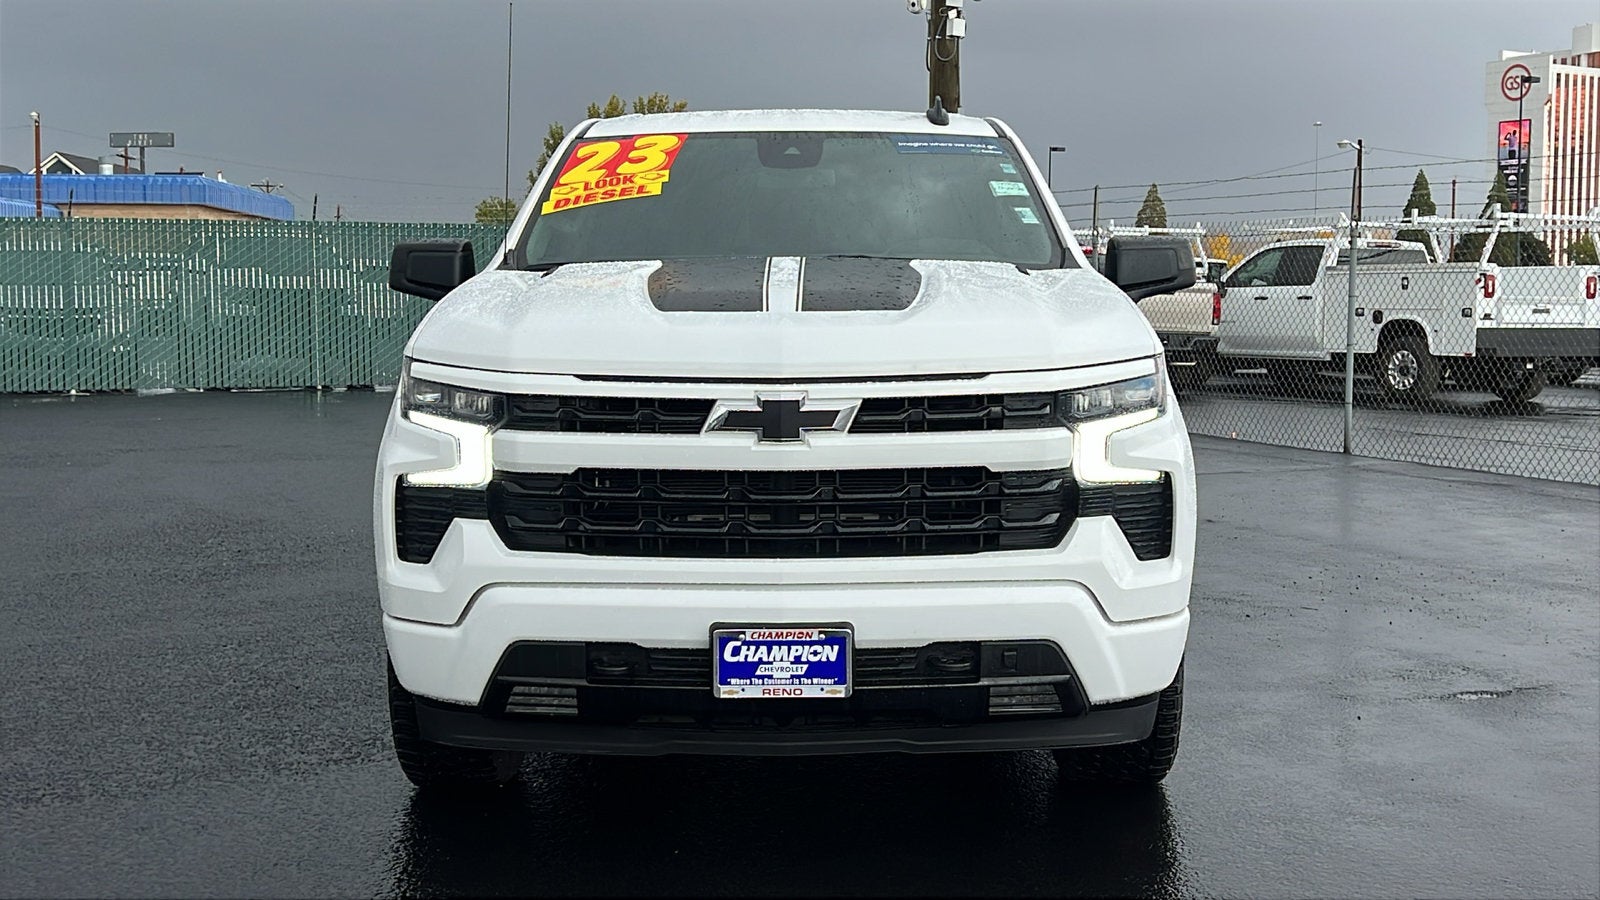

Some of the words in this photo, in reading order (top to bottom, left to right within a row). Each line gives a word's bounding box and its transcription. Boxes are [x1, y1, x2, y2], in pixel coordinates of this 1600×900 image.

[559, 134, 681, 185] 23
[583, 175, 635, 191] LOOK
[553, 185, 651, 210] DIESEL
[750, 631, 814, 640] CHAMPION
[762, 688, 803, 696] RENO
